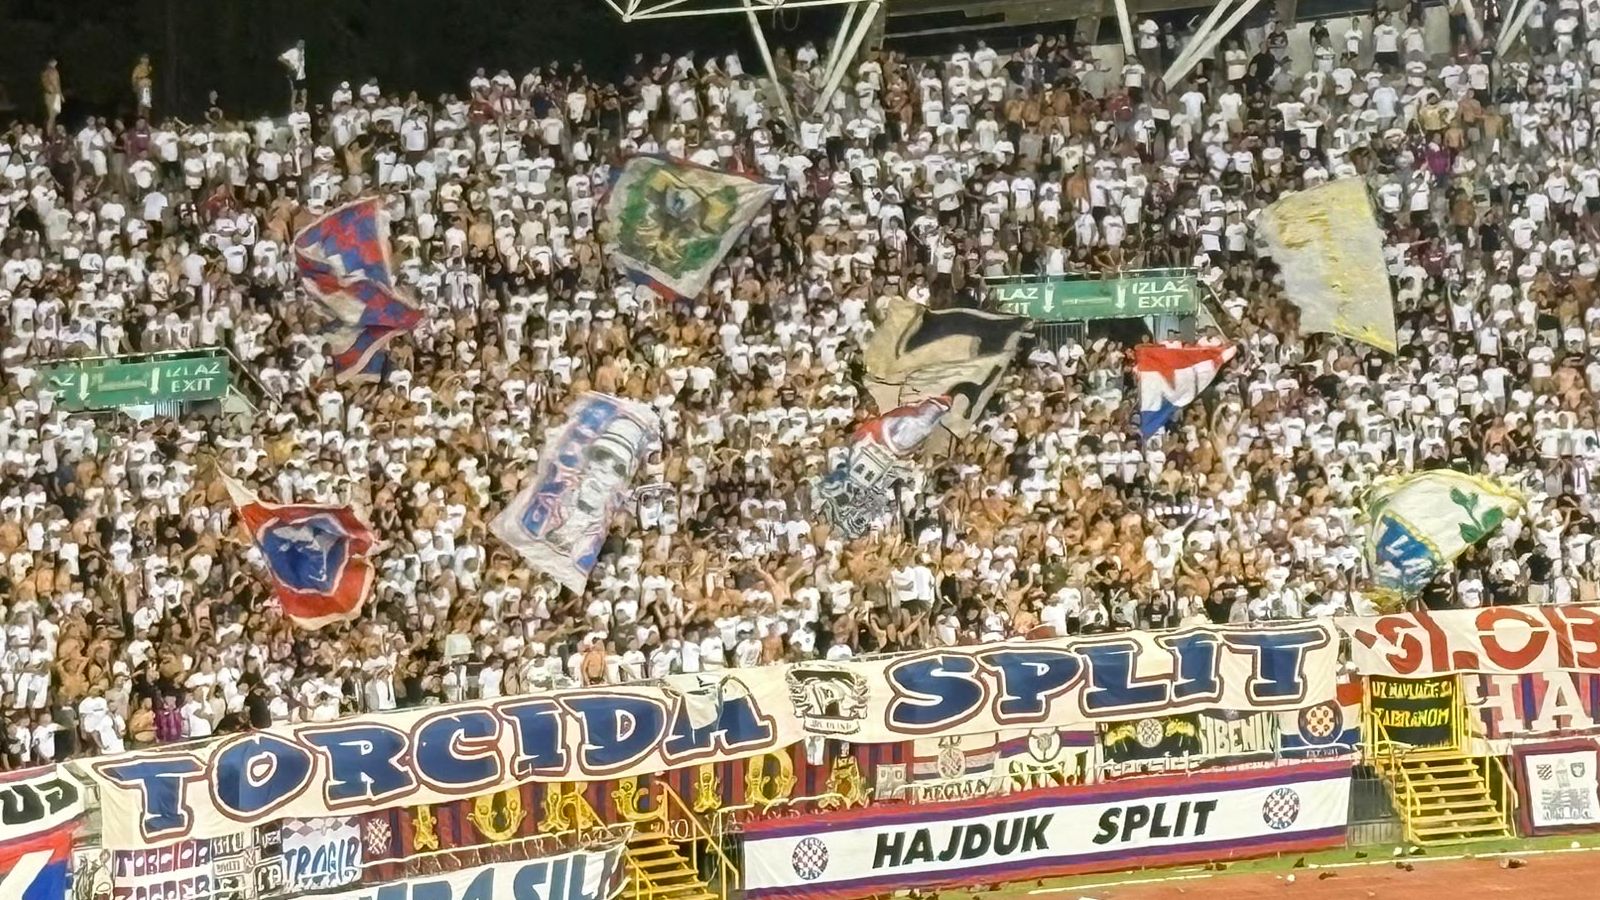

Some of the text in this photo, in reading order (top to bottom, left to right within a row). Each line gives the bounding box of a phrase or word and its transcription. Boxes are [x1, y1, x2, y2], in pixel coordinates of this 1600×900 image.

[1138, 295, 1183, 309] EXIT
[171, 377, 214, 392] EXIT
[93, 626, 1331, 844] TORCIDA SPLIT
[872, 813, 1055, 869] HAJDUK
[1092, 799, 1218, 845] SPLIT
